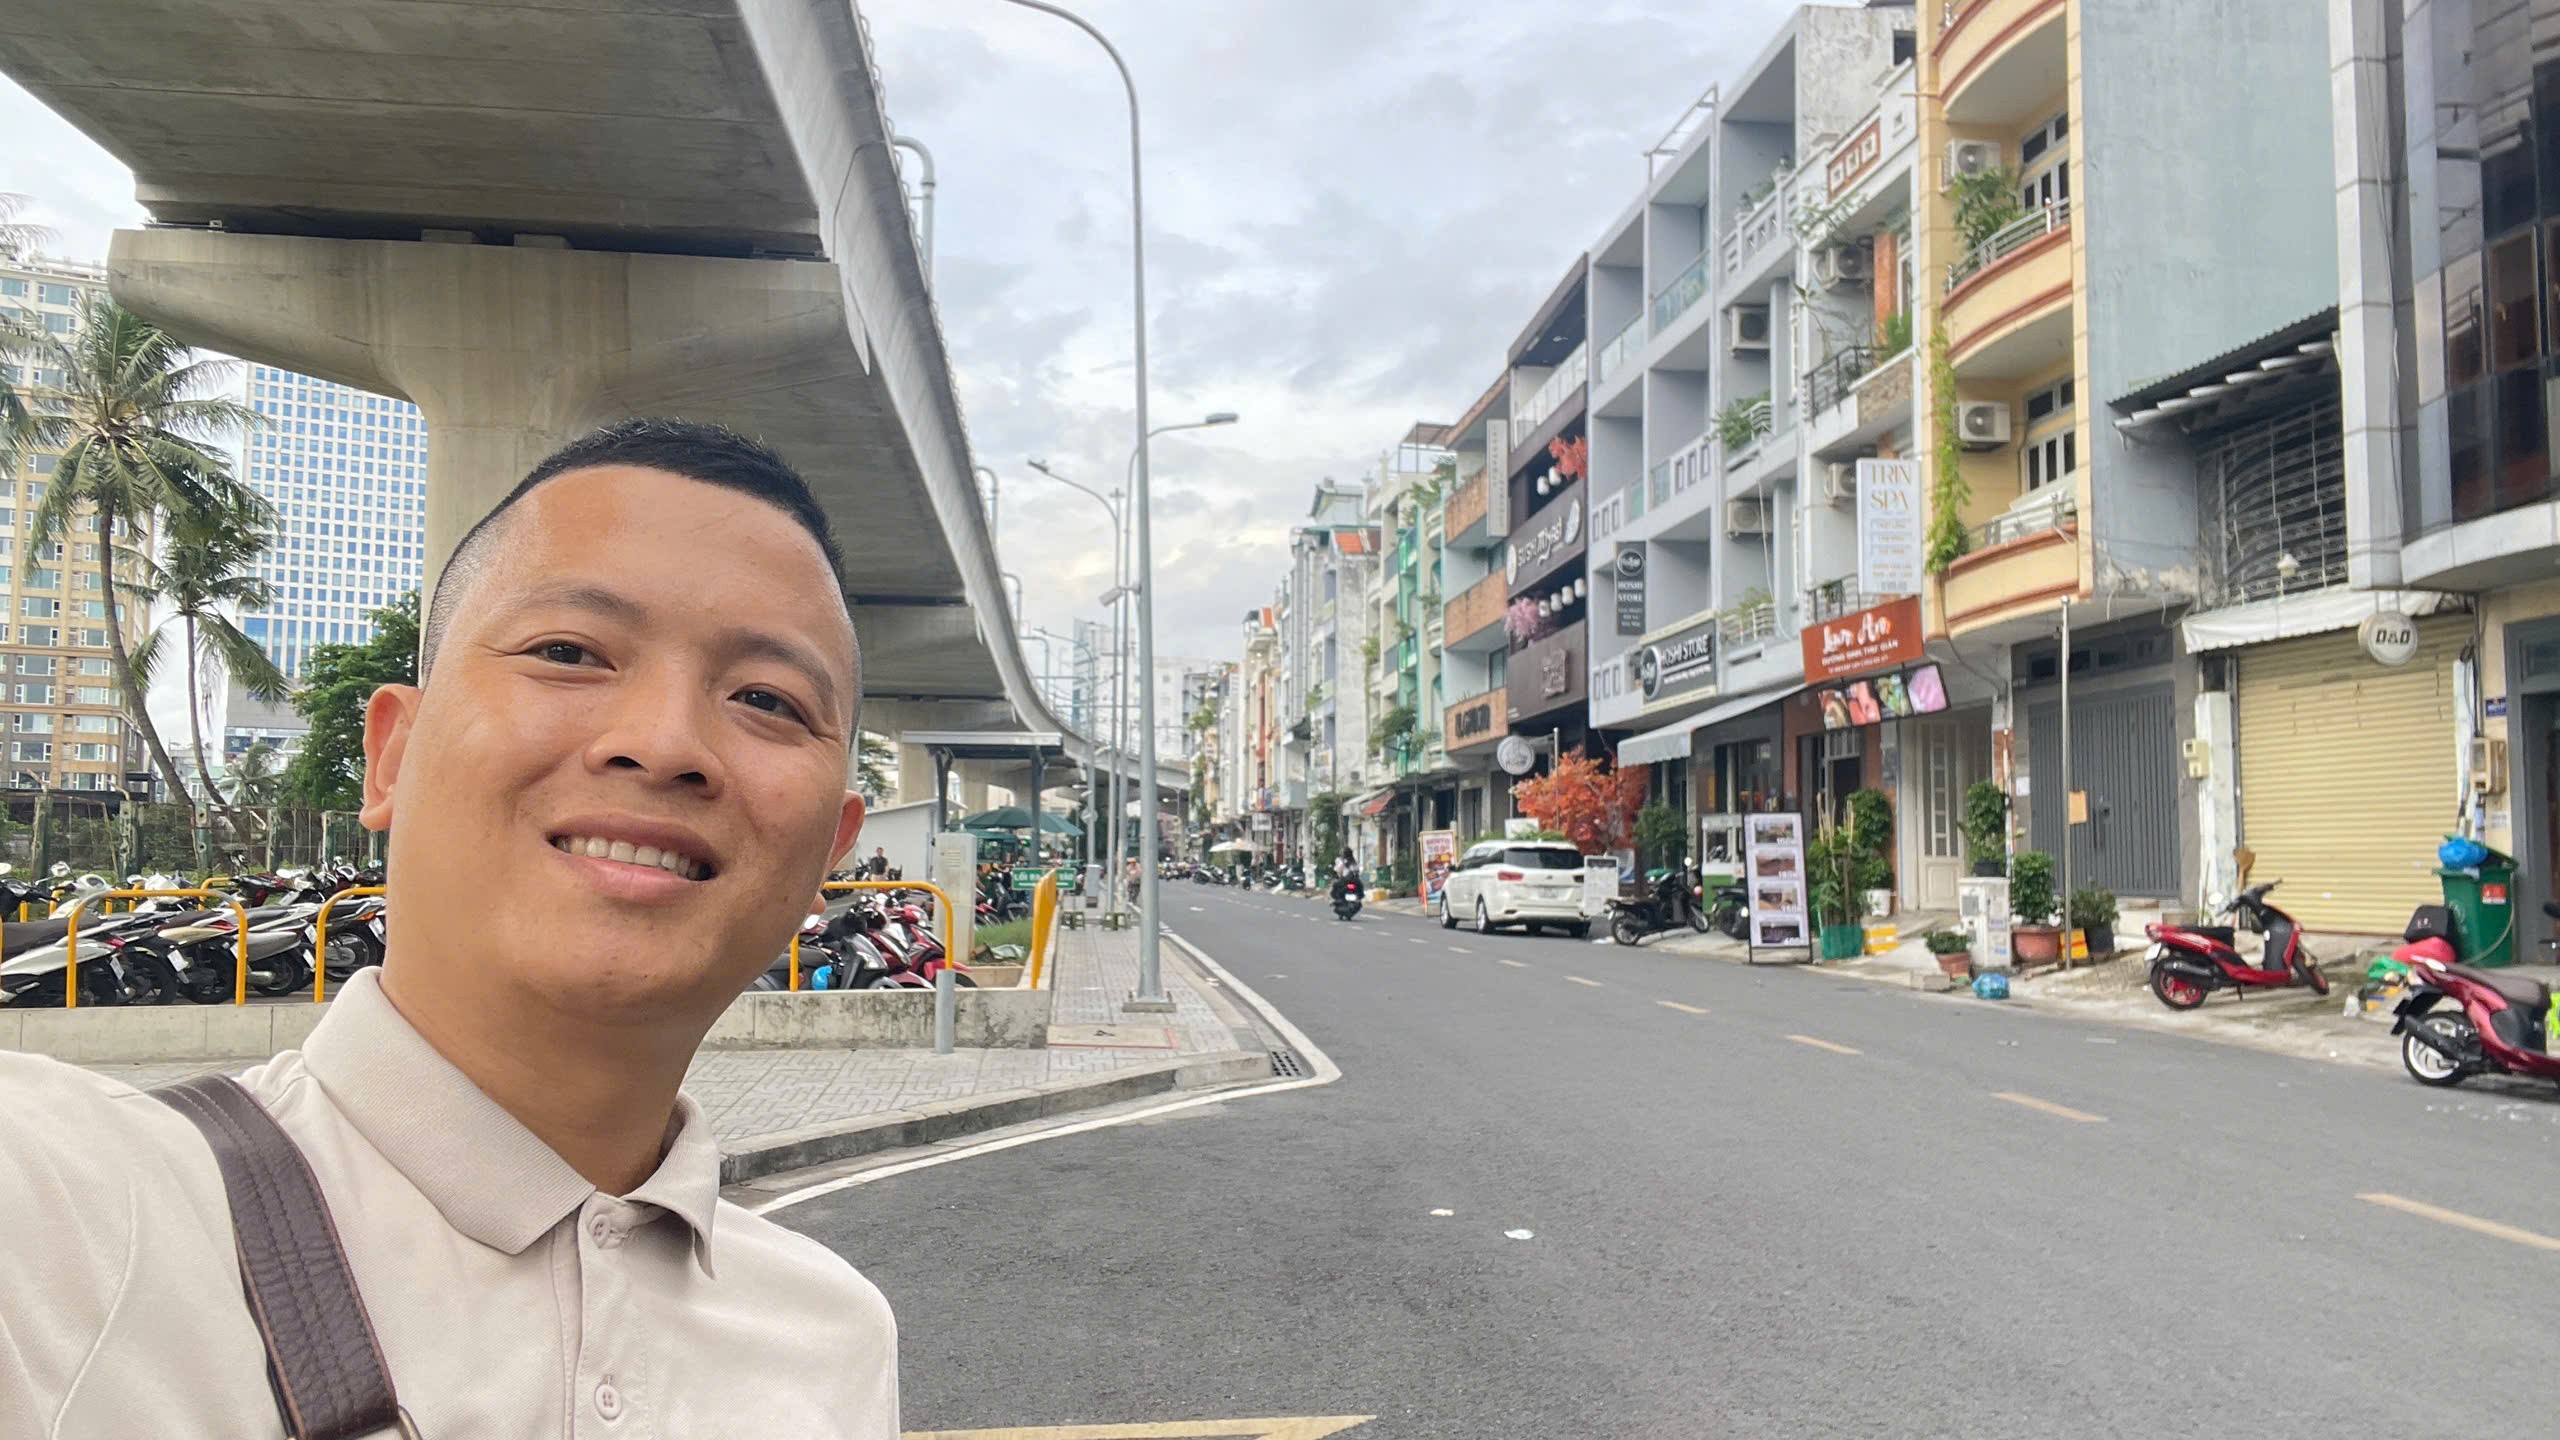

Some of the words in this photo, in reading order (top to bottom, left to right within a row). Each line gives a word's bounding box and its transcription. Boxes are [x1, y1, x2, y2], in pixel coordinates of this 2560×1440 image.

[1872, 464, 1911, 485] TRIN
[1872, 489, 1908, 510] SPA
[1618, 593, 1642, 602] STORE
[1683, 634, 1709, 660] STORE
